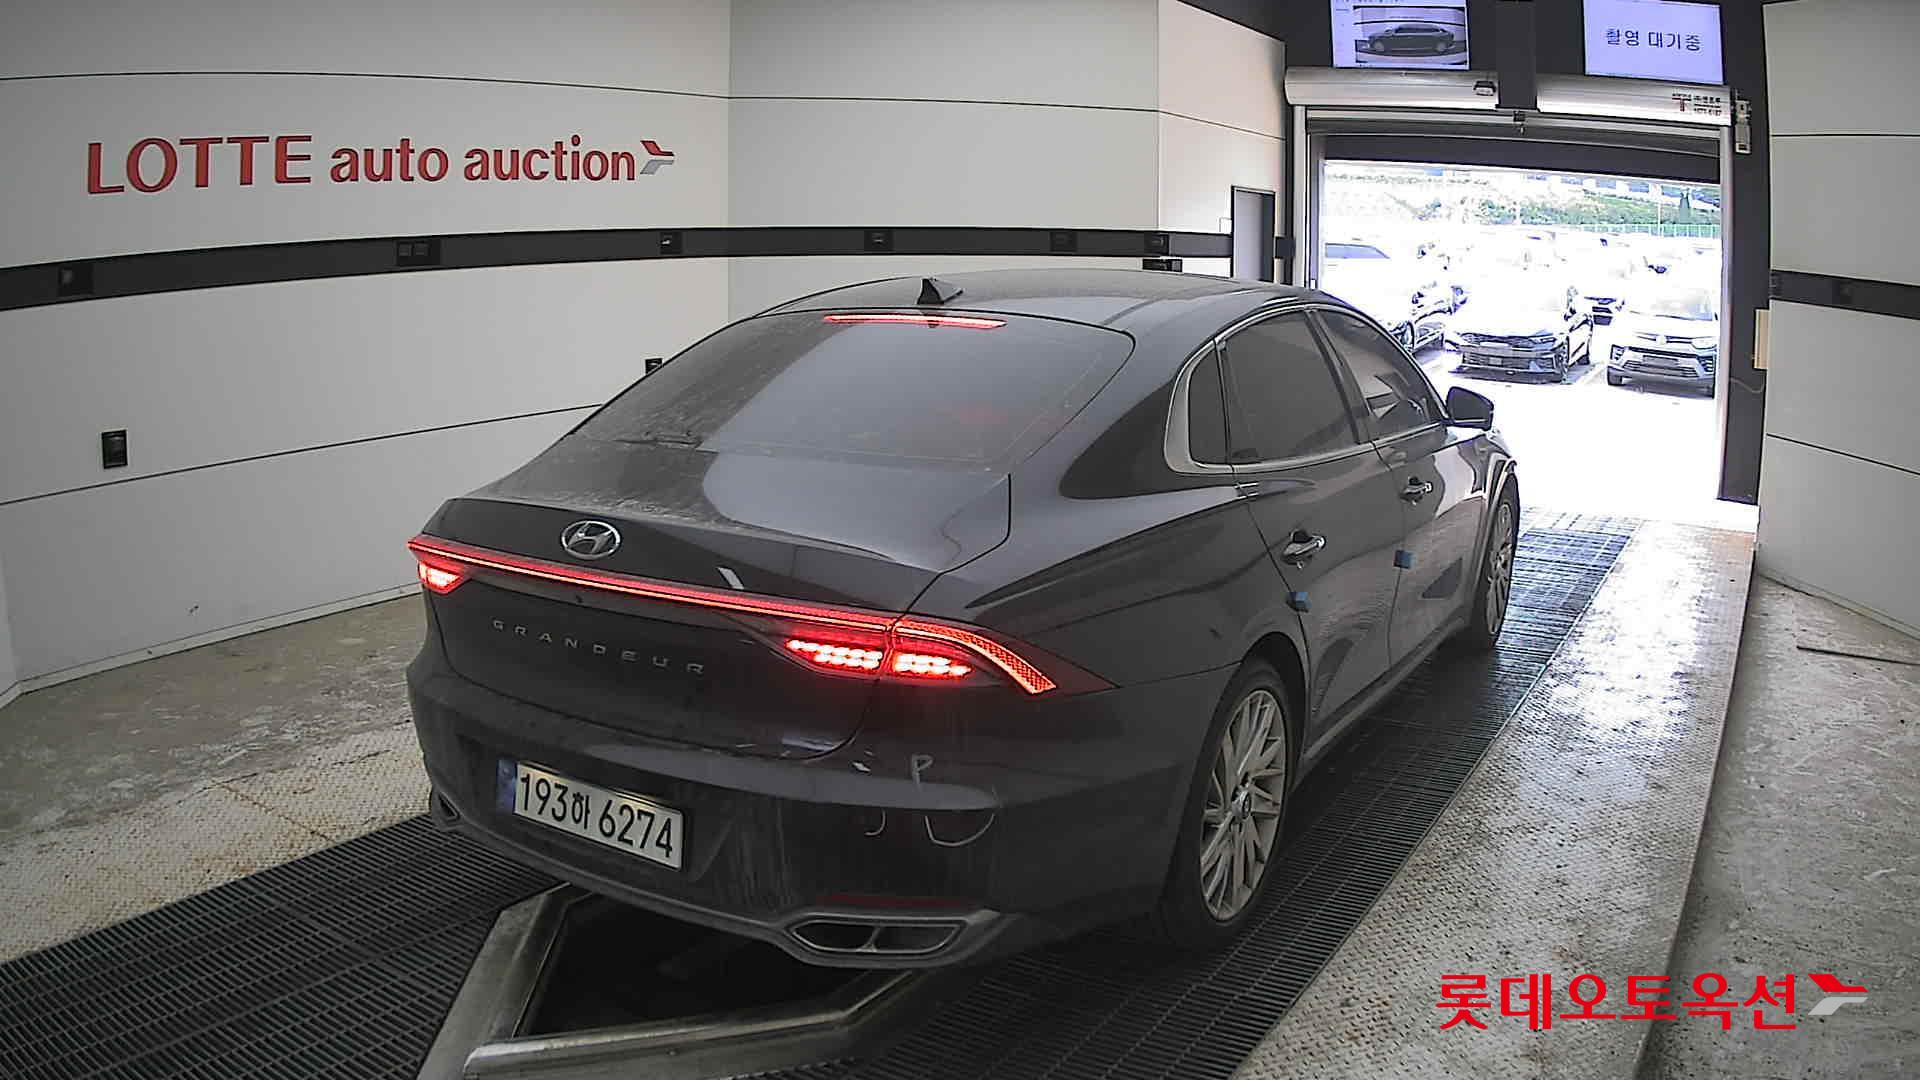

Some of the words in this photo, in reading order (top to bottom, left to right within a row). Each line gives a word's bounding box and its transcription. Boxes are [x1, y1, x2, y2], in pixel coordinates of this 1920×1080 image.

[1607, 29, 1640, 46] 촬영
[1648, 32, 1681, 50] 대기
[87, 136, 312, 194] LOTTE
[329, 138, 449, 183] auto
[463, 135, 637, 183] auction
[492, 619, 705, 676] GRANDEUR
[519, 773, 591, 830] 193하
[599, 799, 674, 858] 6274
